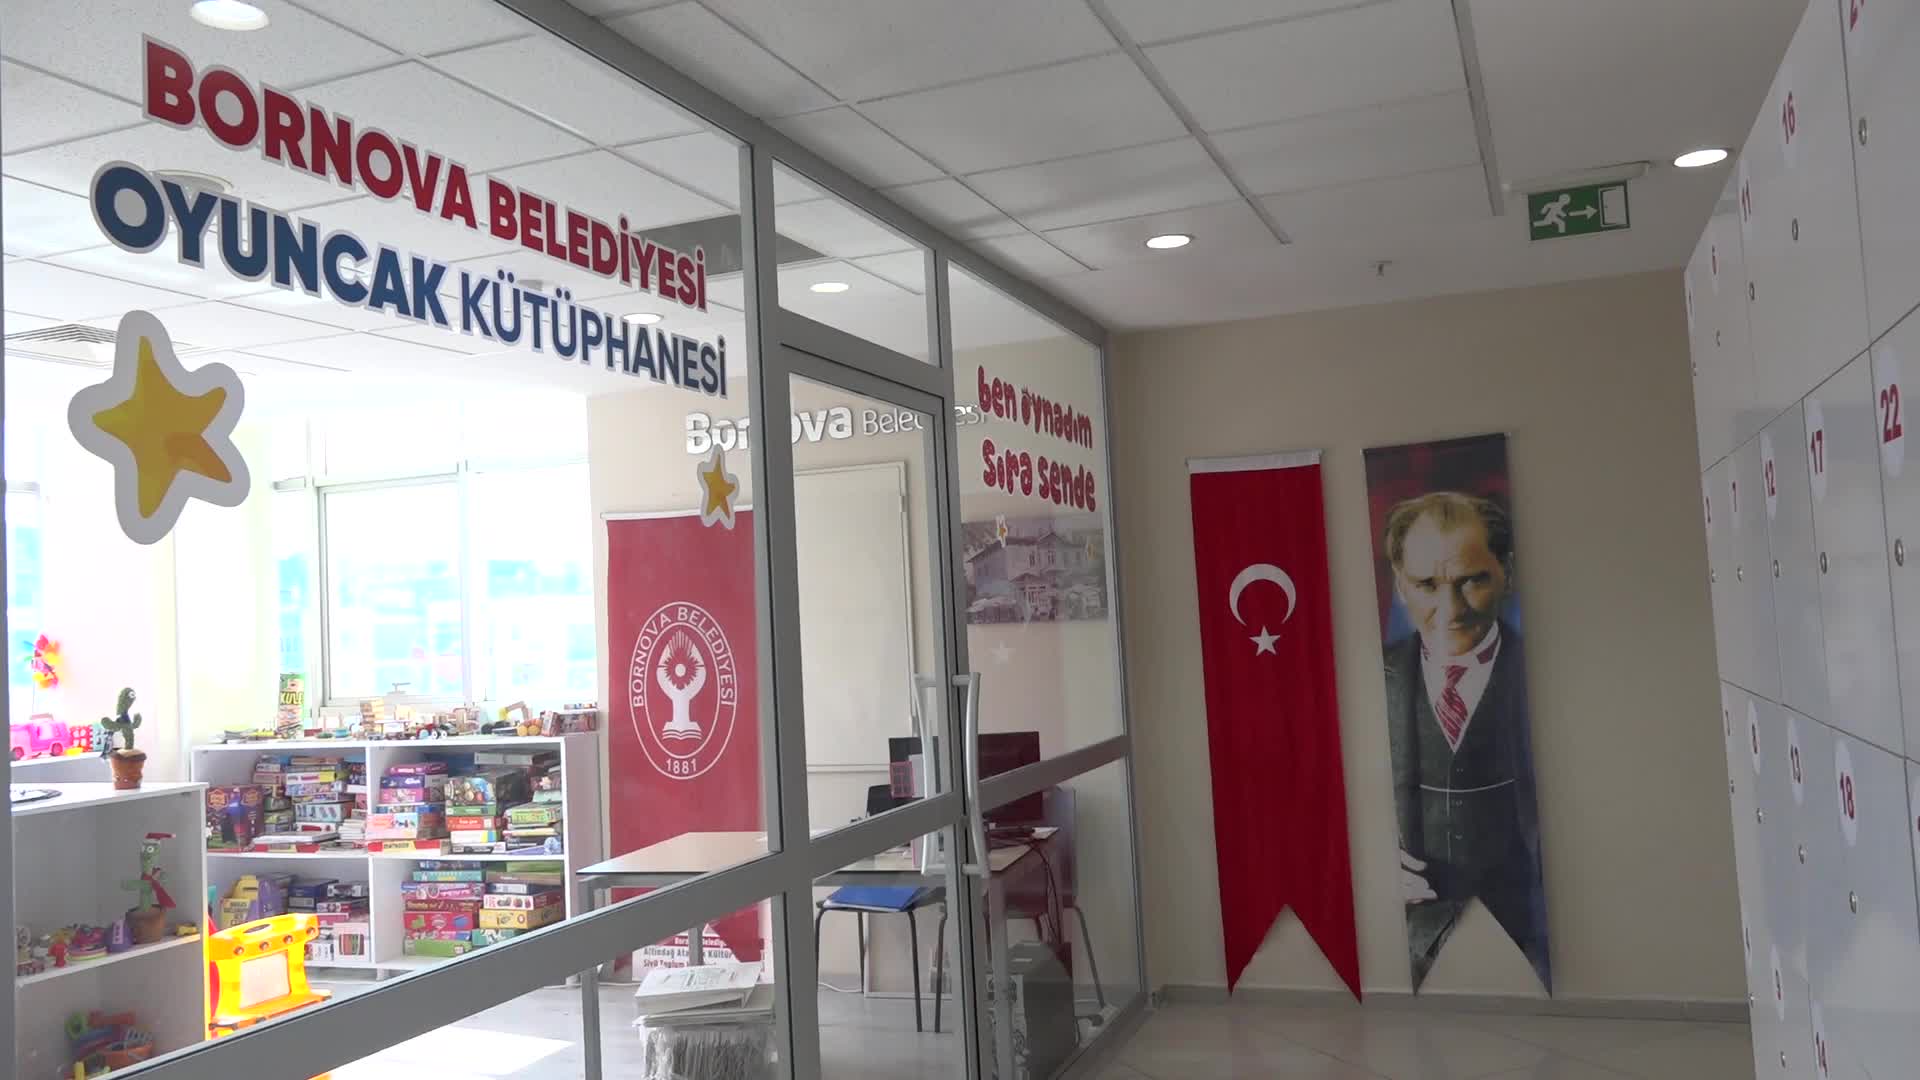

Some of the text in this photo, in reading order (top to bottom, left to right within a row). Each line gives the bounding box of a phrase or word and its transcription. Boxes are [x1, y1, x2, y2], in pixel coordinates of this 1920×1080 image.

[1782, 91, 1796, 144] 16
[146, 40, 707, 308] BORNOVA BELEDİYESİ
[94, 167, 727, 396] OYUNCAK KÜTÜPHANESİ
[978, 365, 1018, 422] ben
[1880, 383, 1904, 444] 22
[686, 406, 853, 454] Borva
[1811, 429, 1824, 474] 17
[1038, 456, 1096, 512] sende
[1765, 459, 1776, 497] 12
[632, 613, 672, 707] BORNOVA
[666, 758, 697, 774] 1881
[1840, 772, 1855, 820] 18
